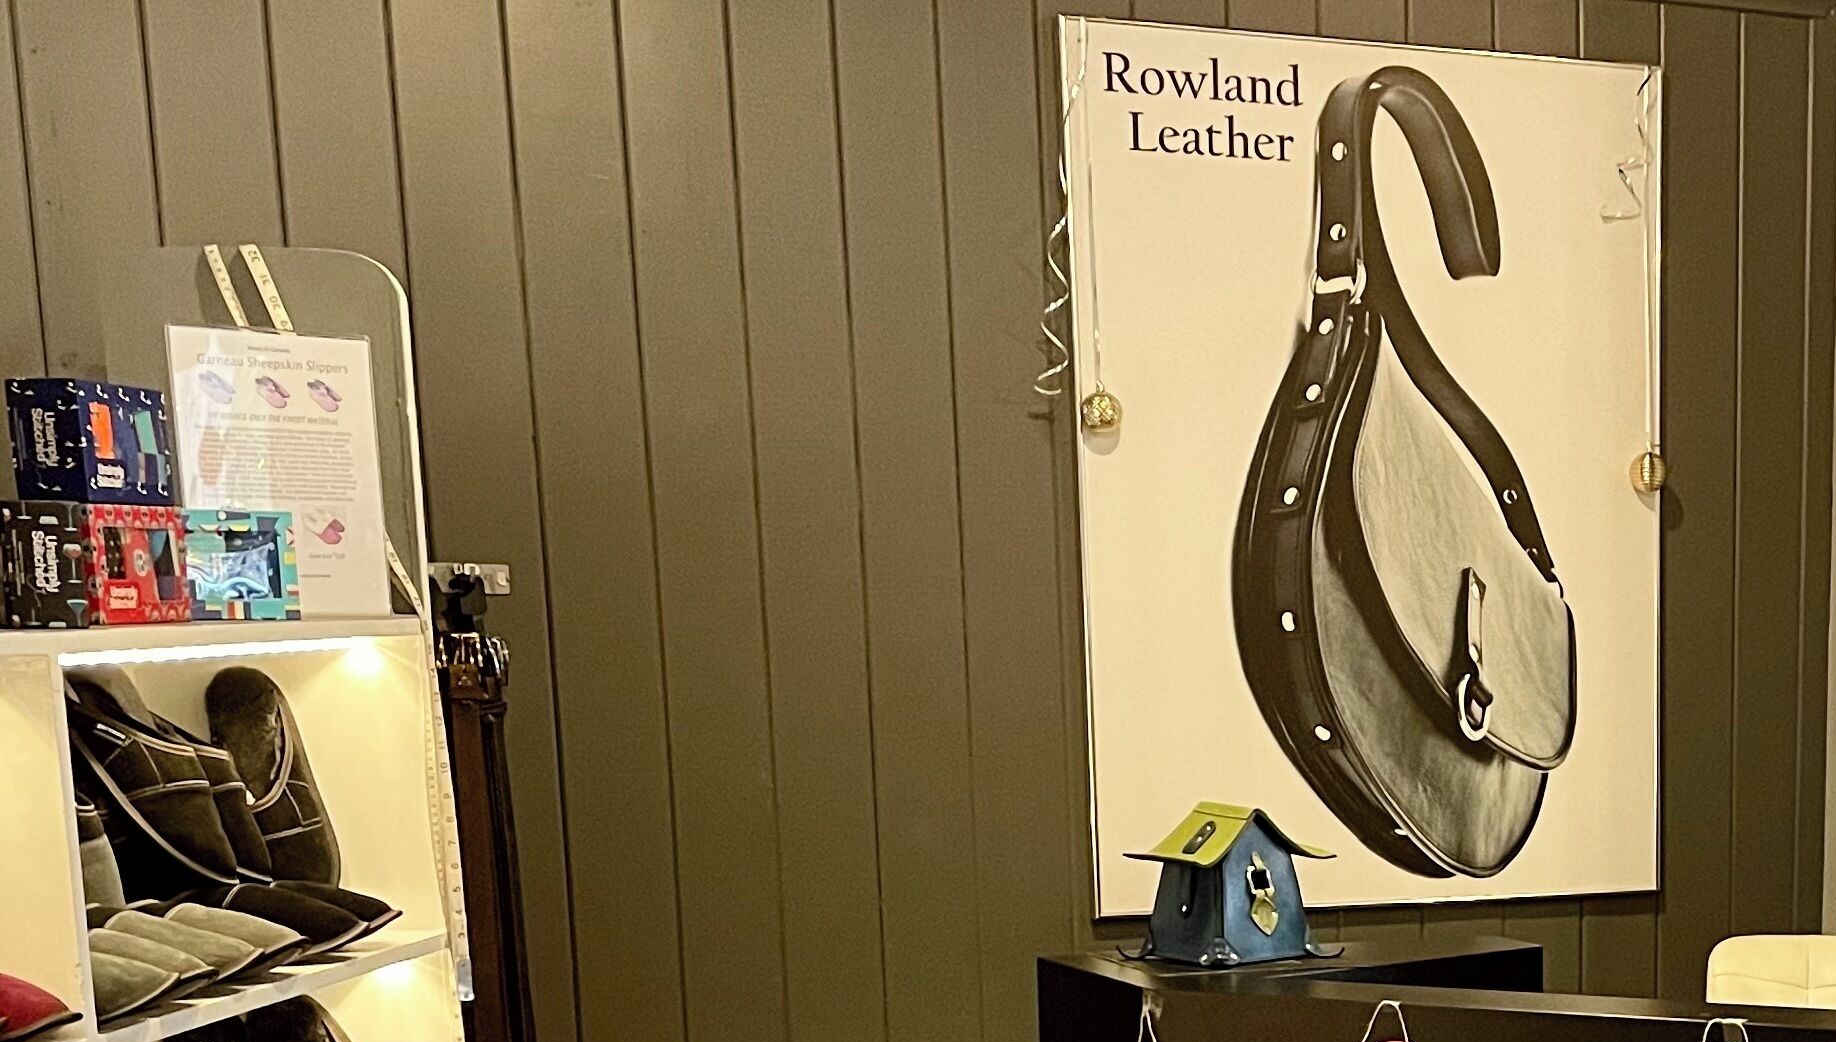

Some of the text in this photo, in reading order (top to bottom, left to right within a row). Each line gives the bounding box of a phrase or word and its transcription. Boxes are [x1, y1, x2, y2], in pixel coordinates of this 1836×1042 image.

[1101, 51, 1304, 107] Rowland
[1128, 110, 1295, 163] Leather
[196, 353, 349, 375] Garneau Sheepskin Slippers
[31, 530, 47, 588] Stitched
[45, 535, 61, 593] Unsimply
